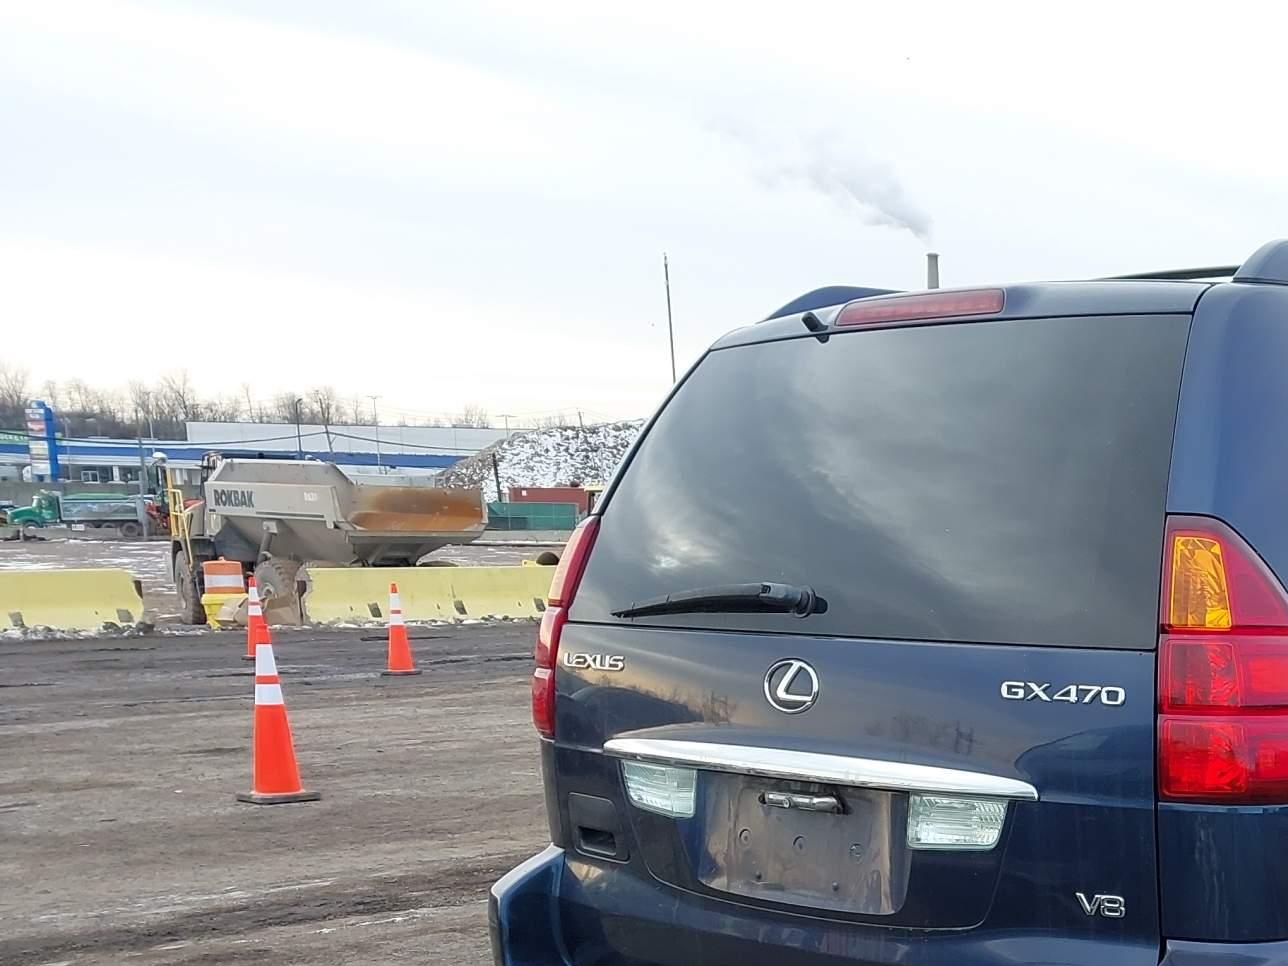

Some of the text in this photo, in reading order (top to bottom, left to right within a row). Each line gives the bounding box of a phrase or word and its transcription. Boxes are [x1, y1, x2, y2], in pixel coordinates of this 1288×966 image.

[213, 489, 255, 508] ROKBAK
[563, 652, 624, 671] LEXUS
[1075, 892, 1125, 918] V8
